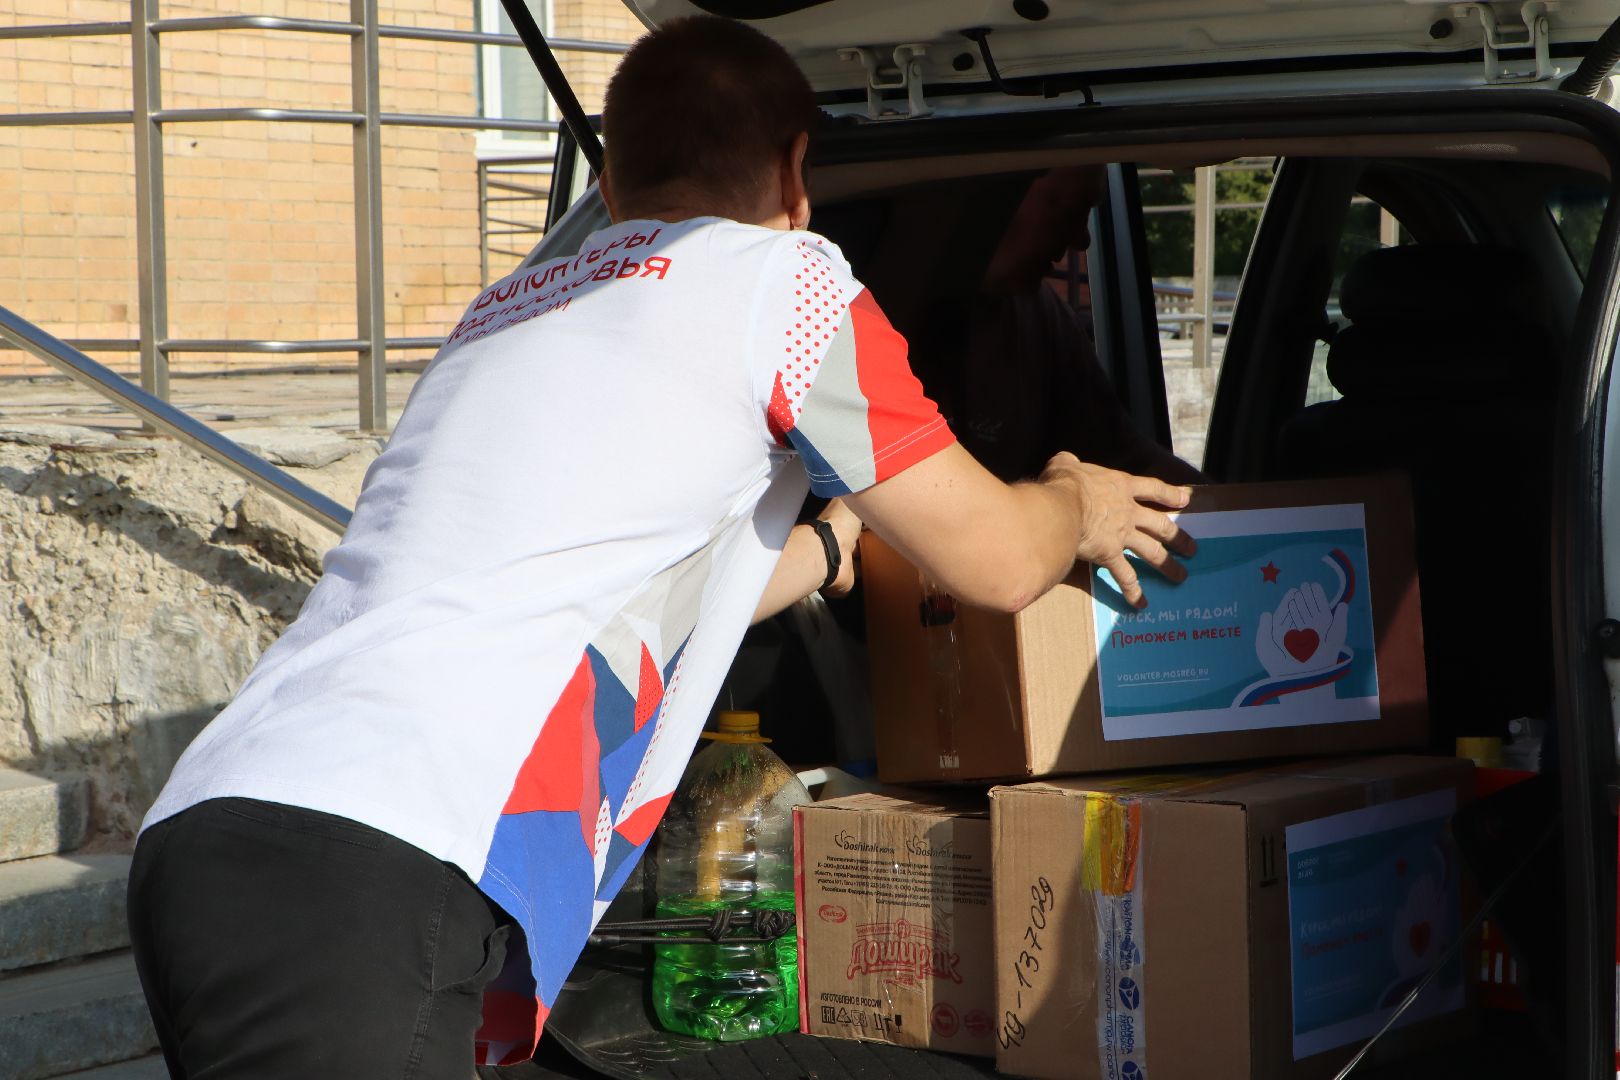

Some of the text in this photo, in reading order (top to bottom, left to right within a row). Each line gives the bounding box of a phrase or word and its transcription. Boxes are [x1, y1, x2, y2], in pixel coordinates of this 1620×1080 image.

[1158, 609, 1180, 622] МЫ
[1185, 601, 1238, 620] РЯДОМ!
[1192, 626, 1241, 641] ВМЕСТЕ
